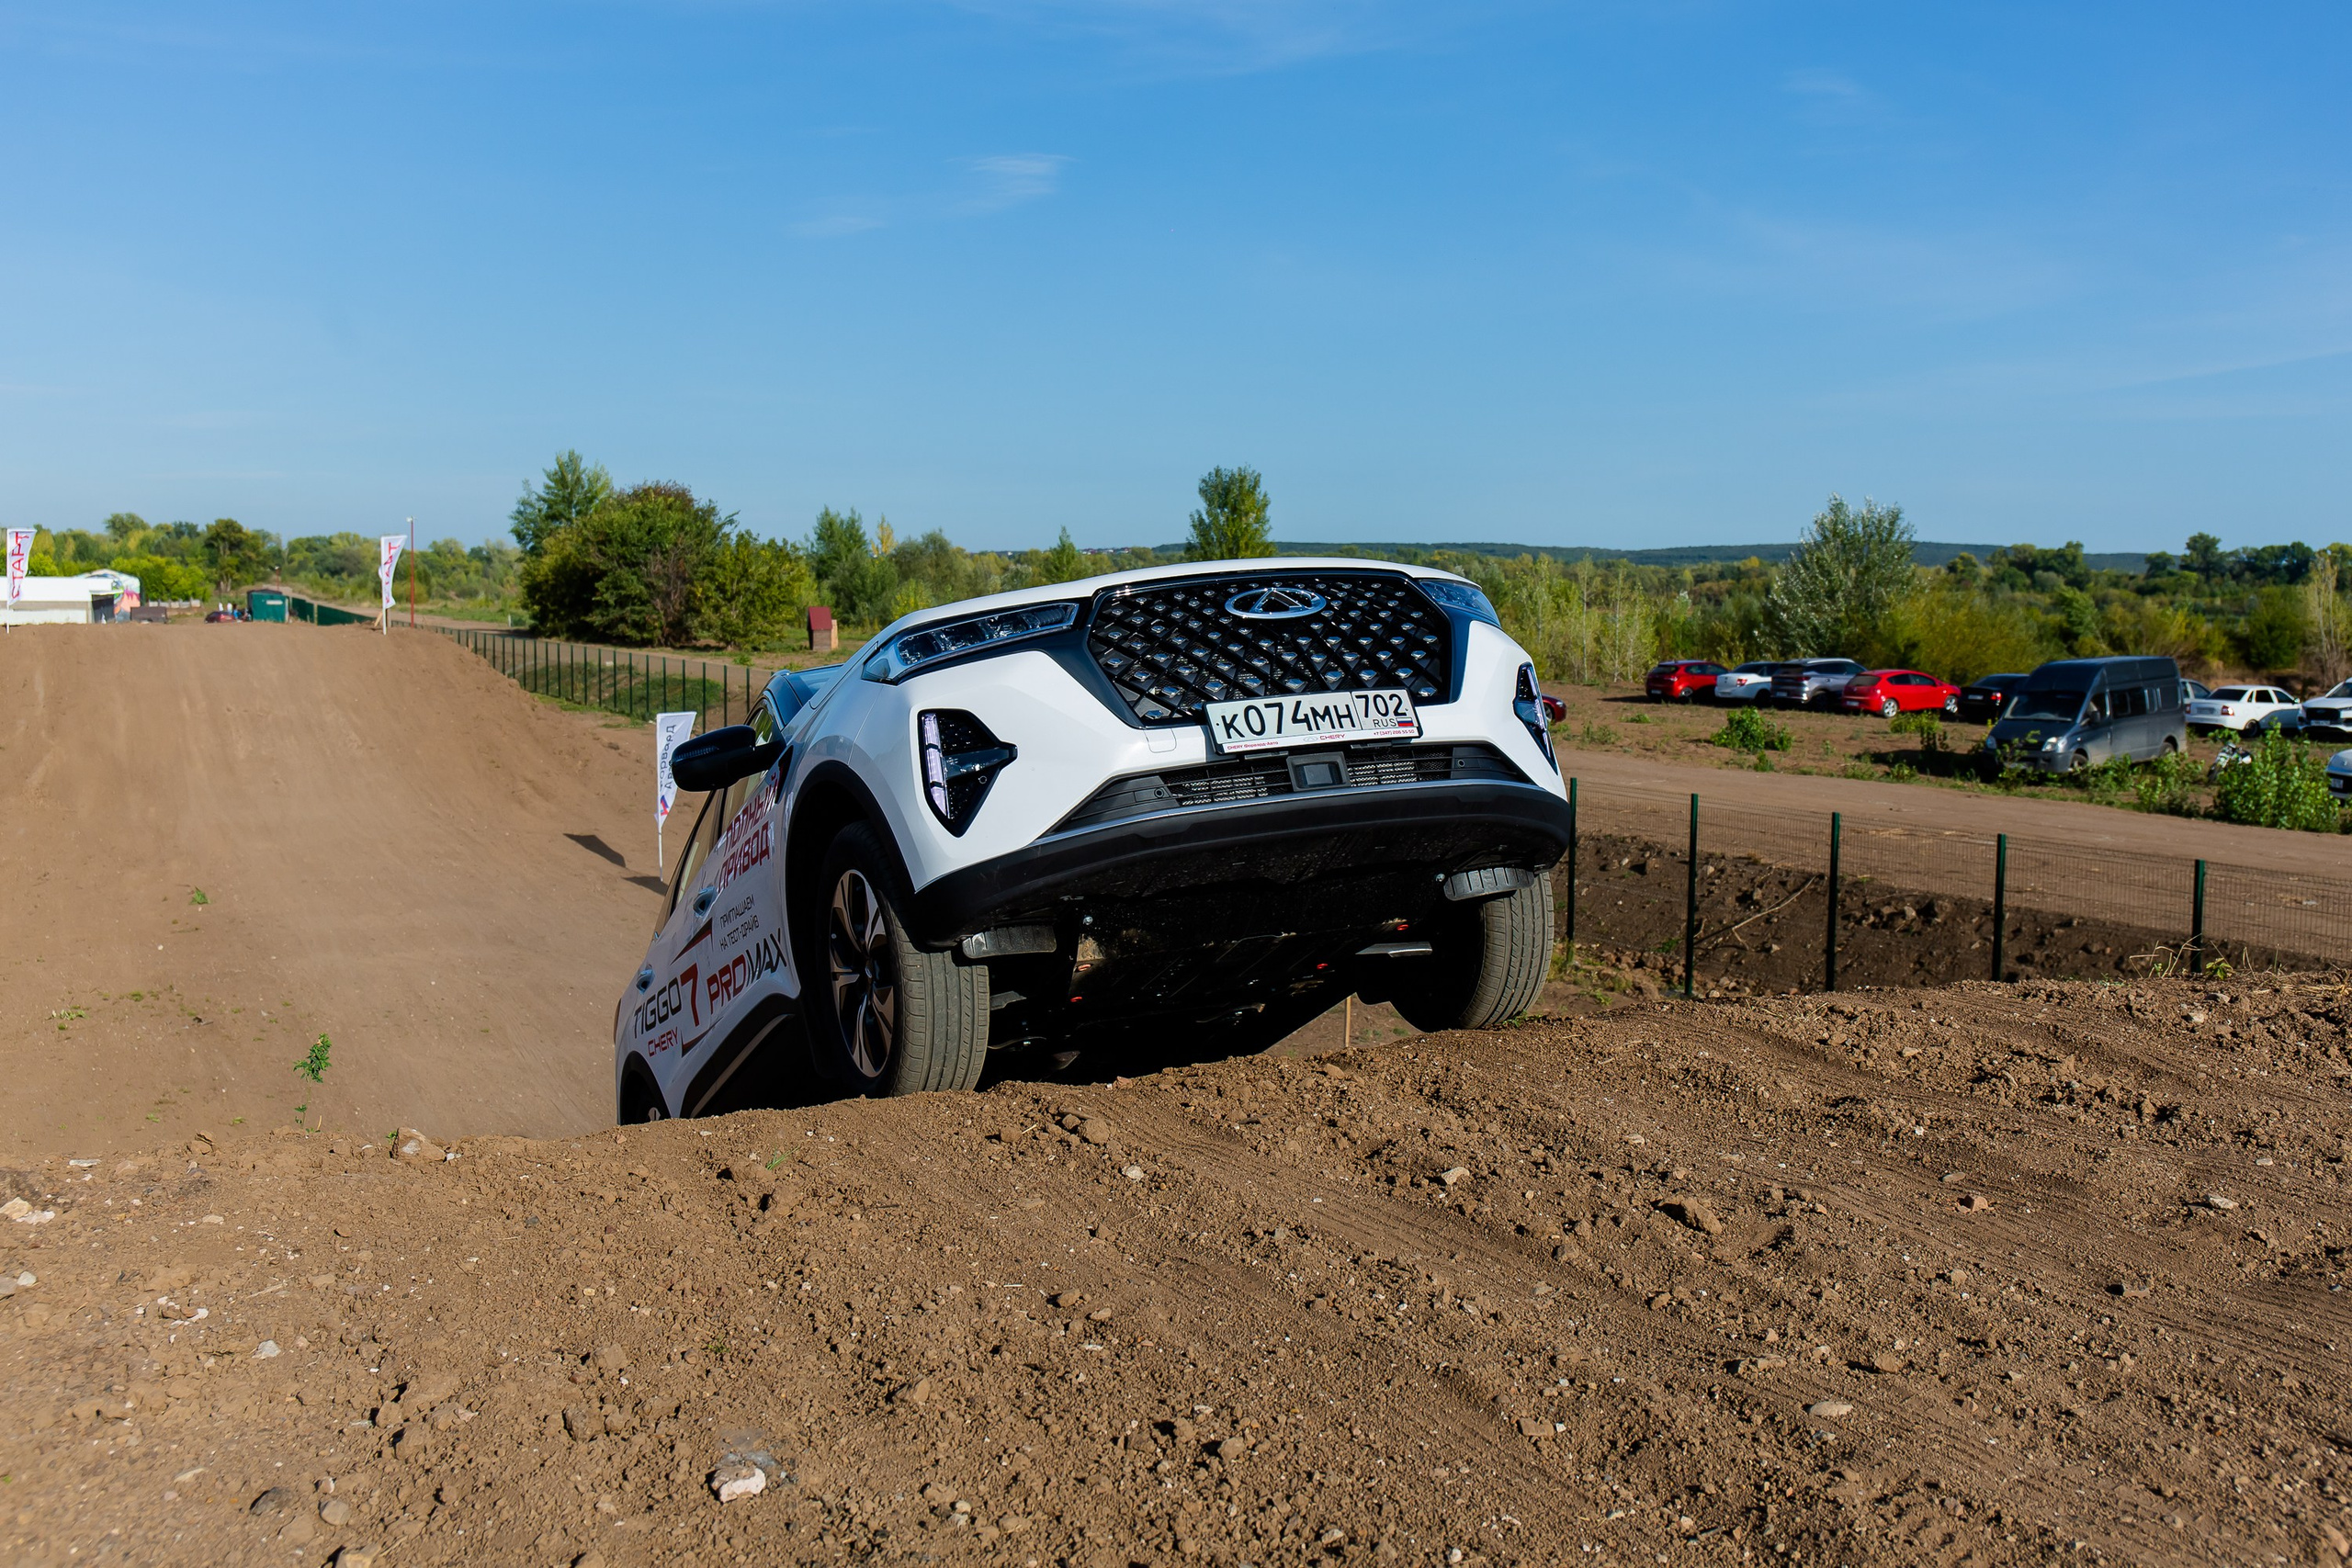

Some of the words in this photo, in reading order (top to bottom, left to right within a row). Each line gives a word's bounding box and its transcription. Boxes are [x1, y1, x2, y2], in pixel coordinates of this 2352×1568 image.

[1355, 694, 1408, 718] 702
[1373, 717, 1396, 728] RUS
[723, 773, 778, 857] ПОЛНЫЙ
[718, 820, 770, 893] ПРИВОД
[719, 894, 754, 930] ПРИГЛАШАЕМ
[719, 938, 729, 952] НА
[727, 915, 760, 948] ТЕСТ-ДРАЙВ
[633, 976, 682, 1039] TIGGO
[680, 962, 699, 1028] 7
[648, 1026, 678, 1057] CHERY
